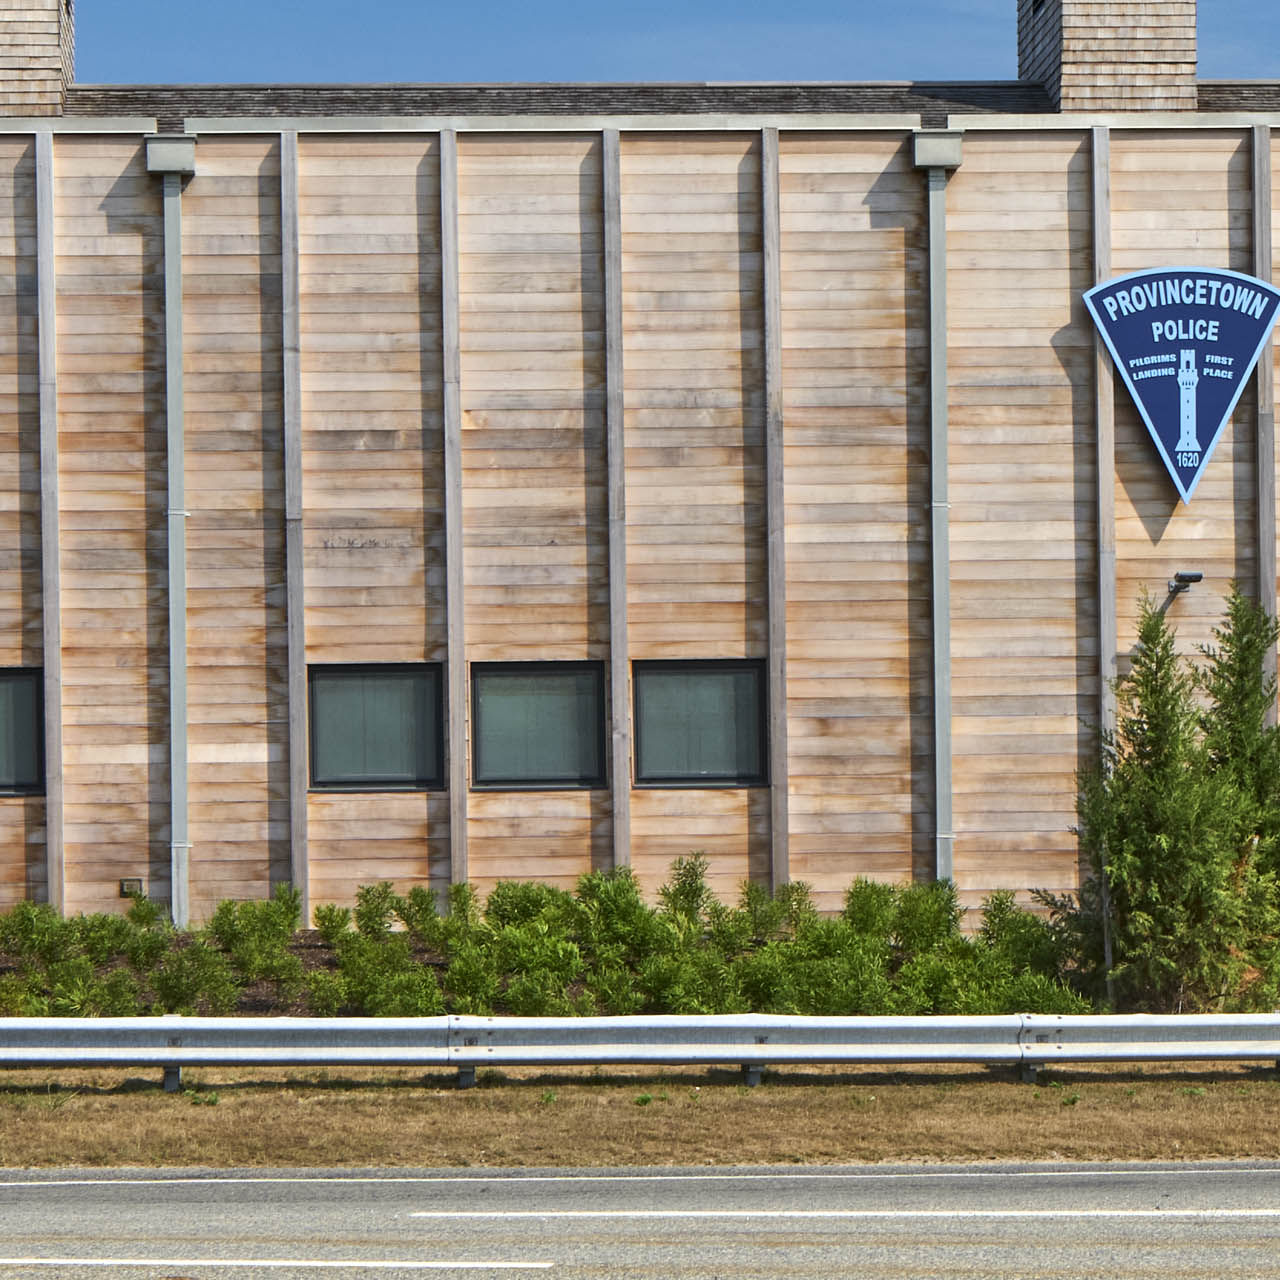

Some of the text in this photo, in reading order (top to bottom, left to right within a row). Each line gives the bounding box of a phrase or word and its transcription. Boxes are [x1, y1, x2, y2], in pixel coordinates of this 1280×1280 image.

[1102, 279, 1269, 321] PROVINCETOWN
[1151, 320, 1220, 342] POLICE
[1129, 353, 1235, 368] PILGRIMS FIRST
[1132, 367, 1234, 381] LANDING PLACE
[1176, 452, 1200, 468] 1620
